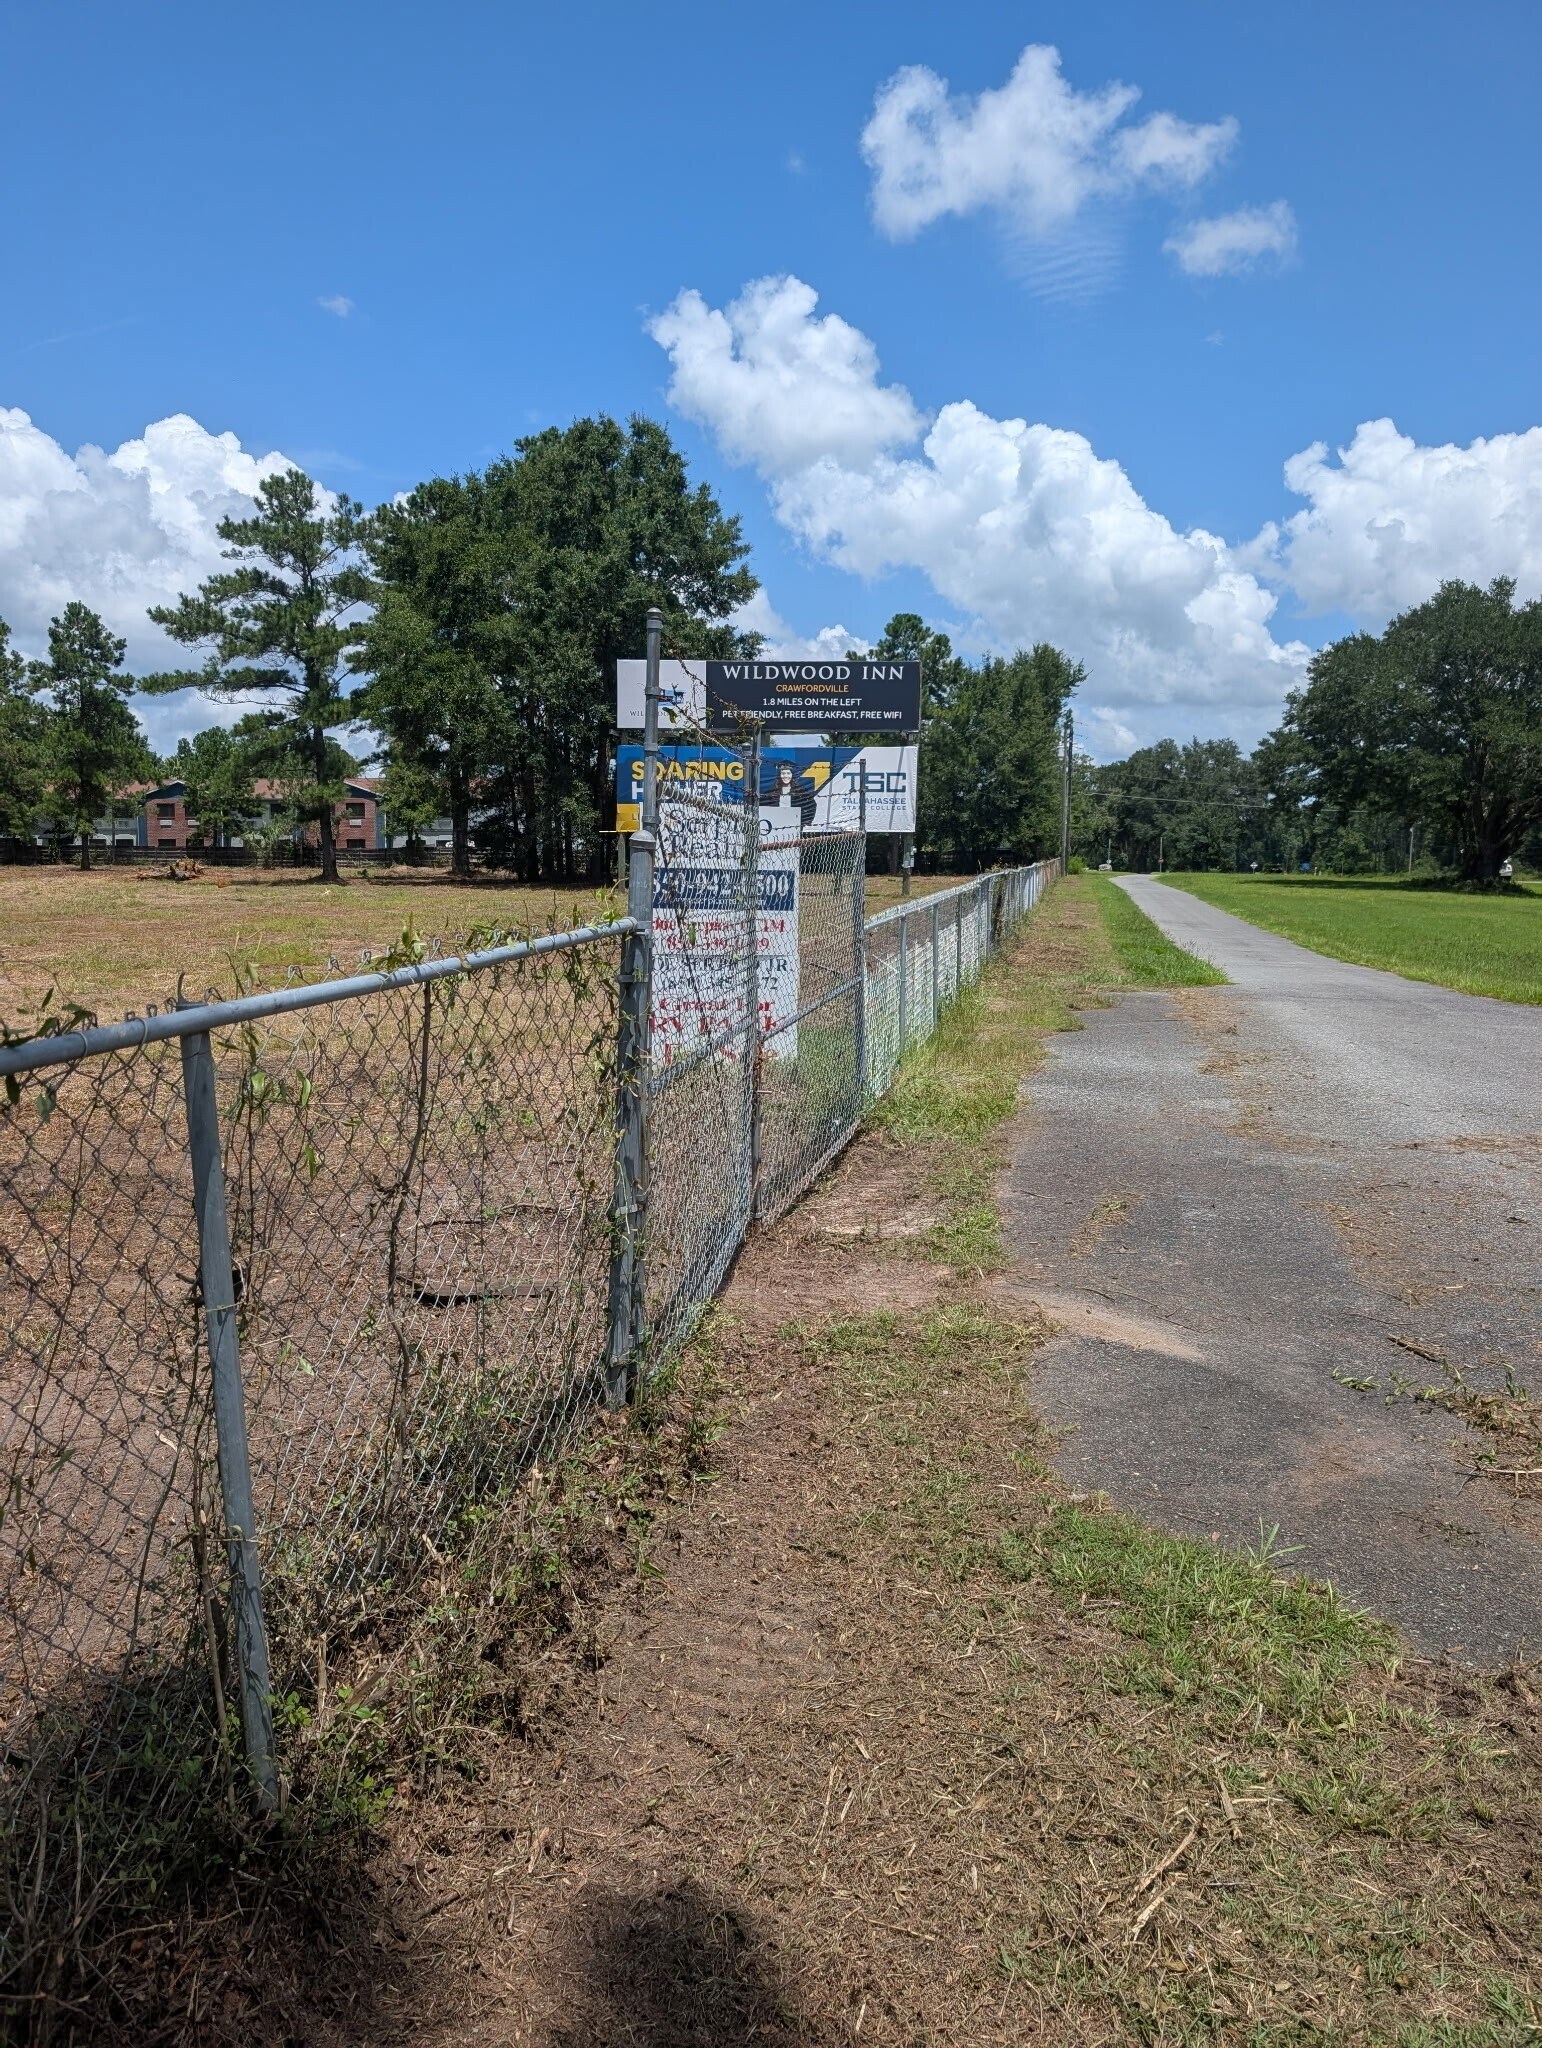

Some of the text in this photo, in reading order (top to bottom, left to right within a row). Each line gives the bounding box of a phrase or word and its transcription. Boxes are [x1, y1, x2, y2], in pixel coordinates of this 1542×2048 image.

[722, 665, 904, 680] WILDWOOD INN
[775, 684, 849, 693] CRAWFORDVILLE
[762, 697, 776, 706] 1.8
[777, 698, 803, 706] MILES
[804, 698, 818, 706] ON
[820, 698, 839, 706] THE
[722, 710, 738, 718] PET
[784, 711, 806, 719] FREE
[807, 711, 859, 720] BREAKFAST,
[860, 711, 882, 719] FREE
[843, 772, 907, 793] TSC
[842, 797, 907, 805] TALAHASSEE
